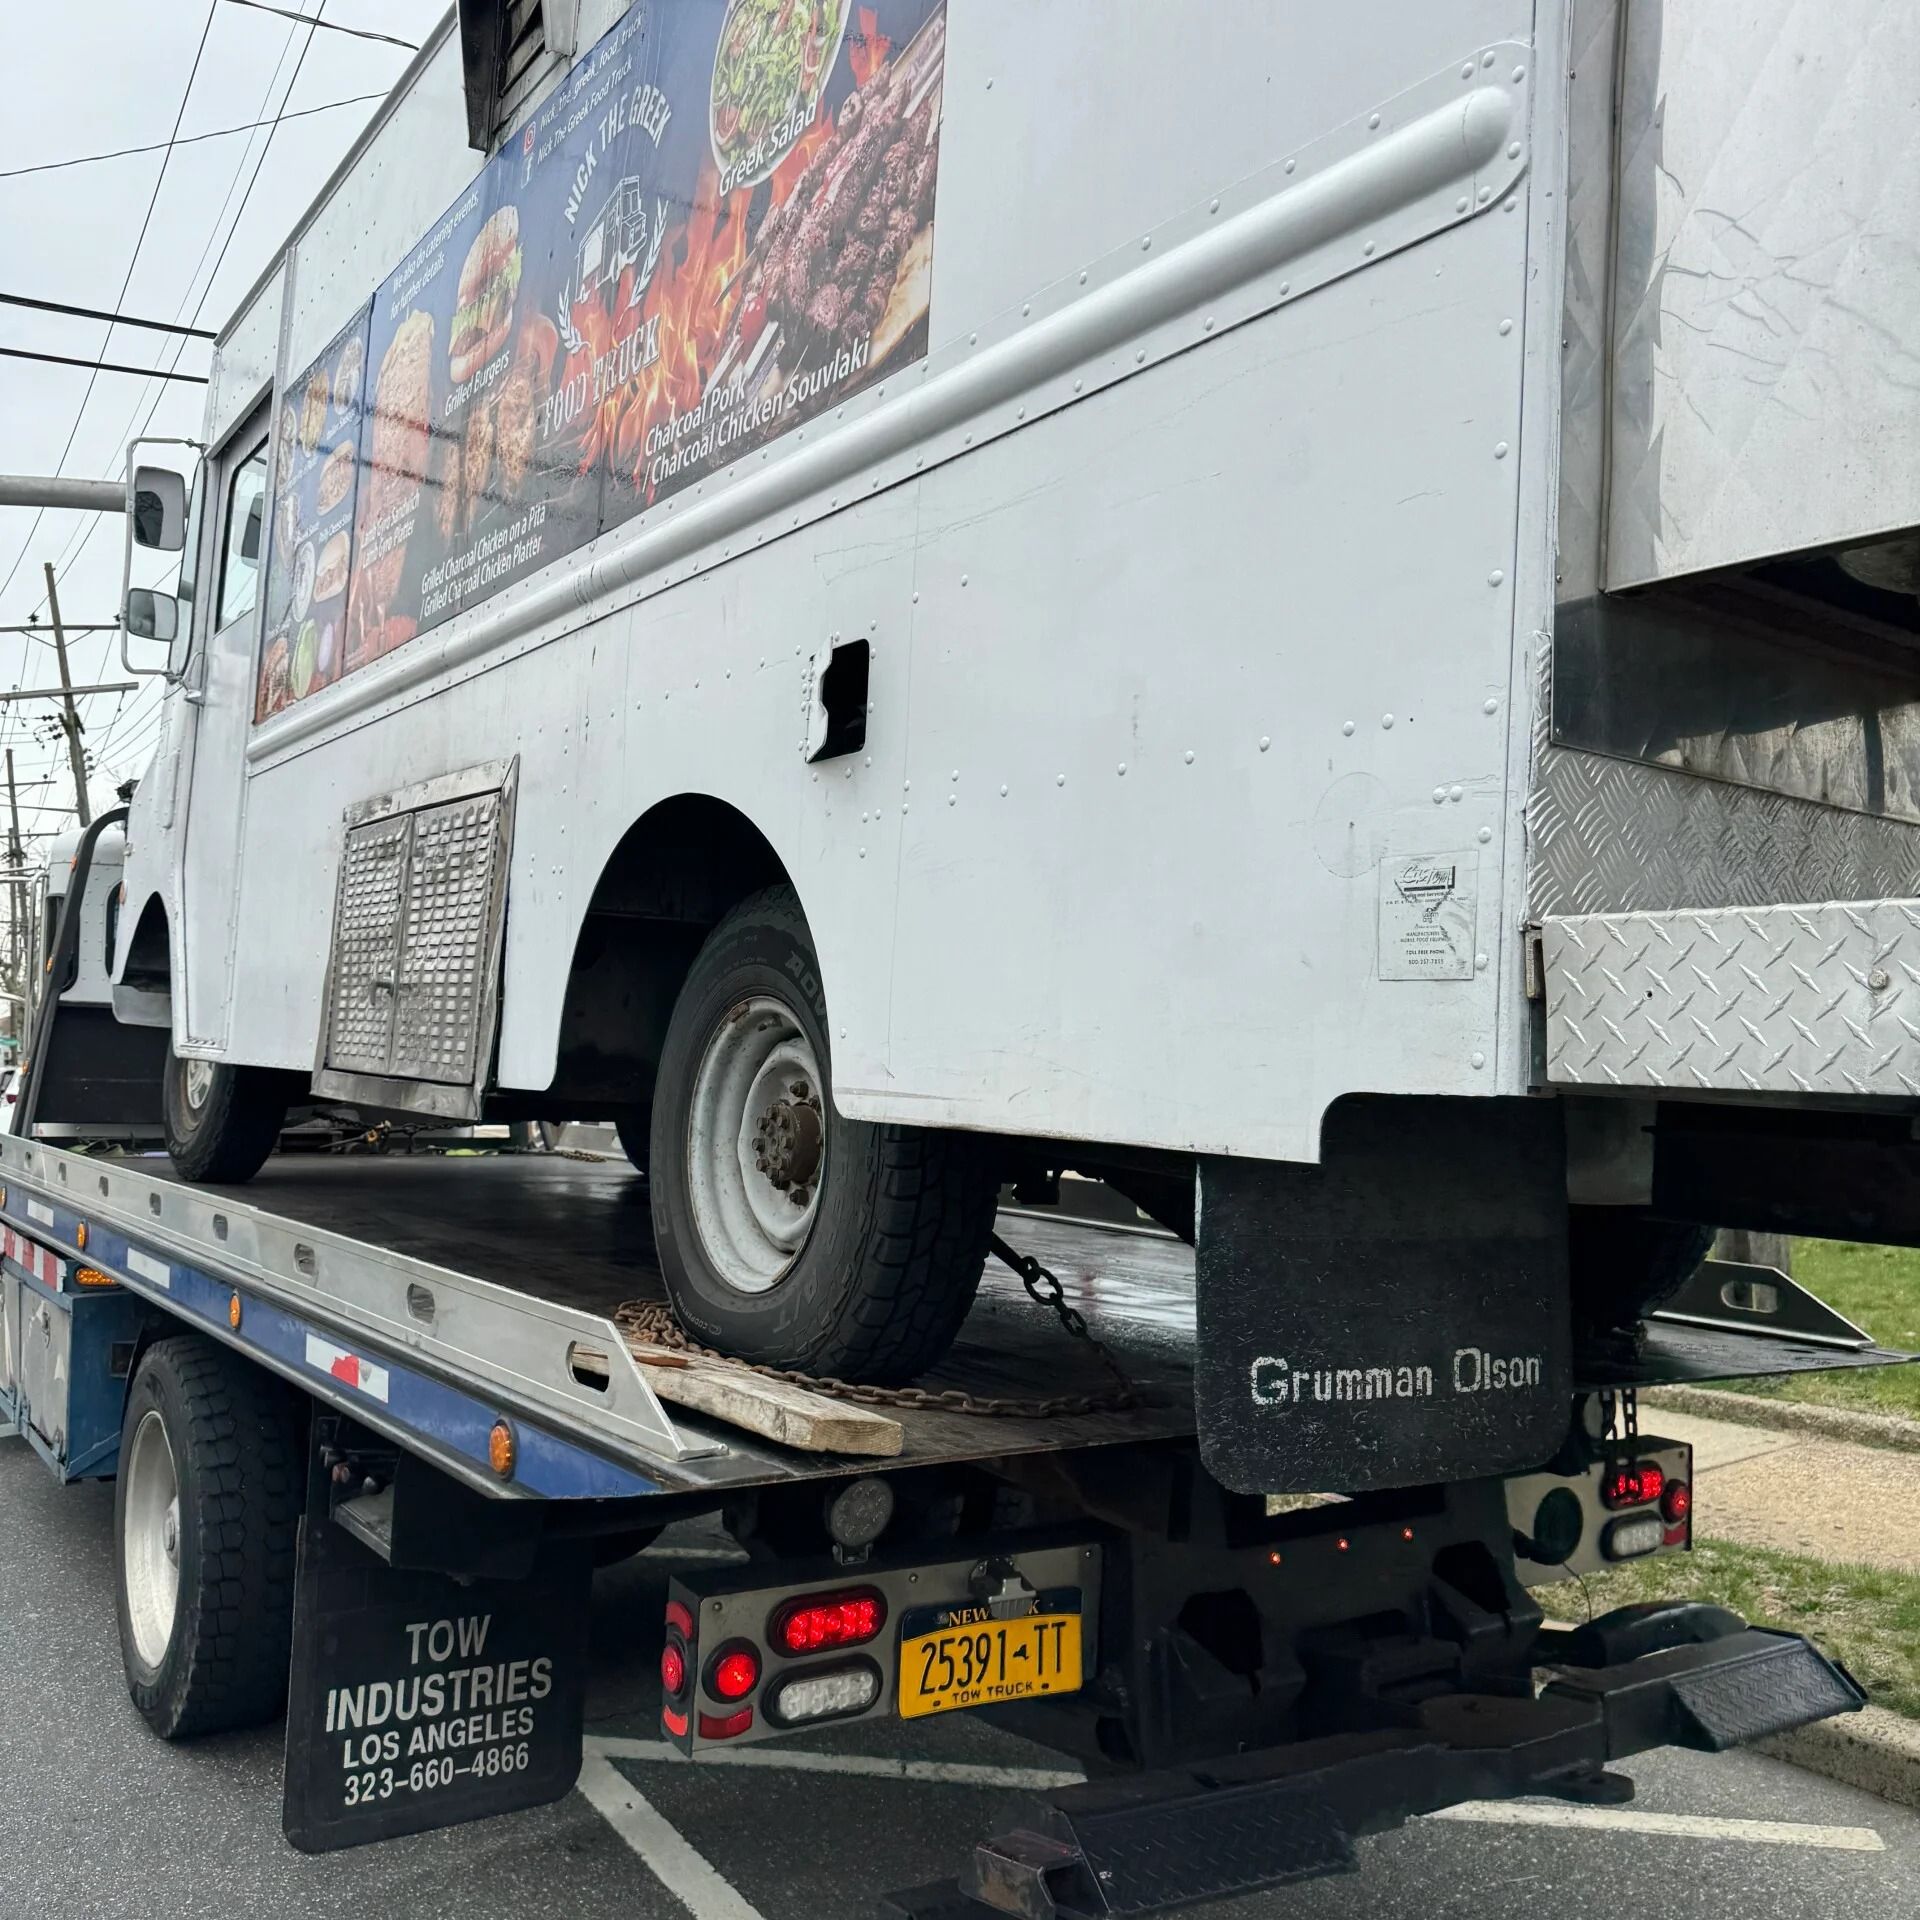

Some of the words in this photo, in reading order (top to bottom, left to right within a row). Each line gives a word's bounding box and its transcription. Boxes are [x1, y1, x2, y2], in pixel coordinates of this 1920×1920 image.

[537, 136, 554, 165] Nick
[554, 125, 567, 148] The
[567, 98, 590, 133] Greek
[589, 75, 611, 111] Food
[611, 53, 633, 89] Truck
[718, 141, 767, 197] Greek
[768, 89, 820, 157] Salad
[563, 141, 599, 224] NICK
[598, 92, 629, 152] THE
[628, 83, 673, 149] GREEK
[444, 373, 473, 417] Grilled
[472, 350, 511, 395] Burgers
[542, 370, 588, 440] FOOD
[592, 313, 661, 407] TRUCK
[717, 392, 785, 447] Chicken
[787, 331, 872, 410] Souvlaki
[644, 393, 708, 458] Charcoal
[709, 373, 748, 420] Pork
[421, 562, 446, 595] Grilled
[444, 541, 478, 581] Charcoal
[477, 528, 508, 562] Chicken
[509, 521, 521, 541] on
[521, 516, 528, 534] a
[527, 504, 546, 532] Pita
[447, 566, 481, 604] Charcoal
[480, 553, 512, 586] Chicken
[512, 534, 543, 569] Platter
[1250, 1355, 1433, 1405] Grumman
[1453, 1347, 1541, 1393] Olson
[405, 1613, 492, 1665] TOW
[948, 1606, 990, 1627] NEW
[325, 1656, 553, 1733] INDUSTRIES
[919, 1629, 1007, 1696] 25391
[1034, 1621, 1067, 1676] TT
[952, 1690, 981, 1704] TOW
[986, 1681, 1033, 1697] TRUCK
[343, 1730, 401, 1769] LOS
[407, 1706, 534, 1757] ANGELES
[343, 1742, 530, 1806] 323-660-4866
